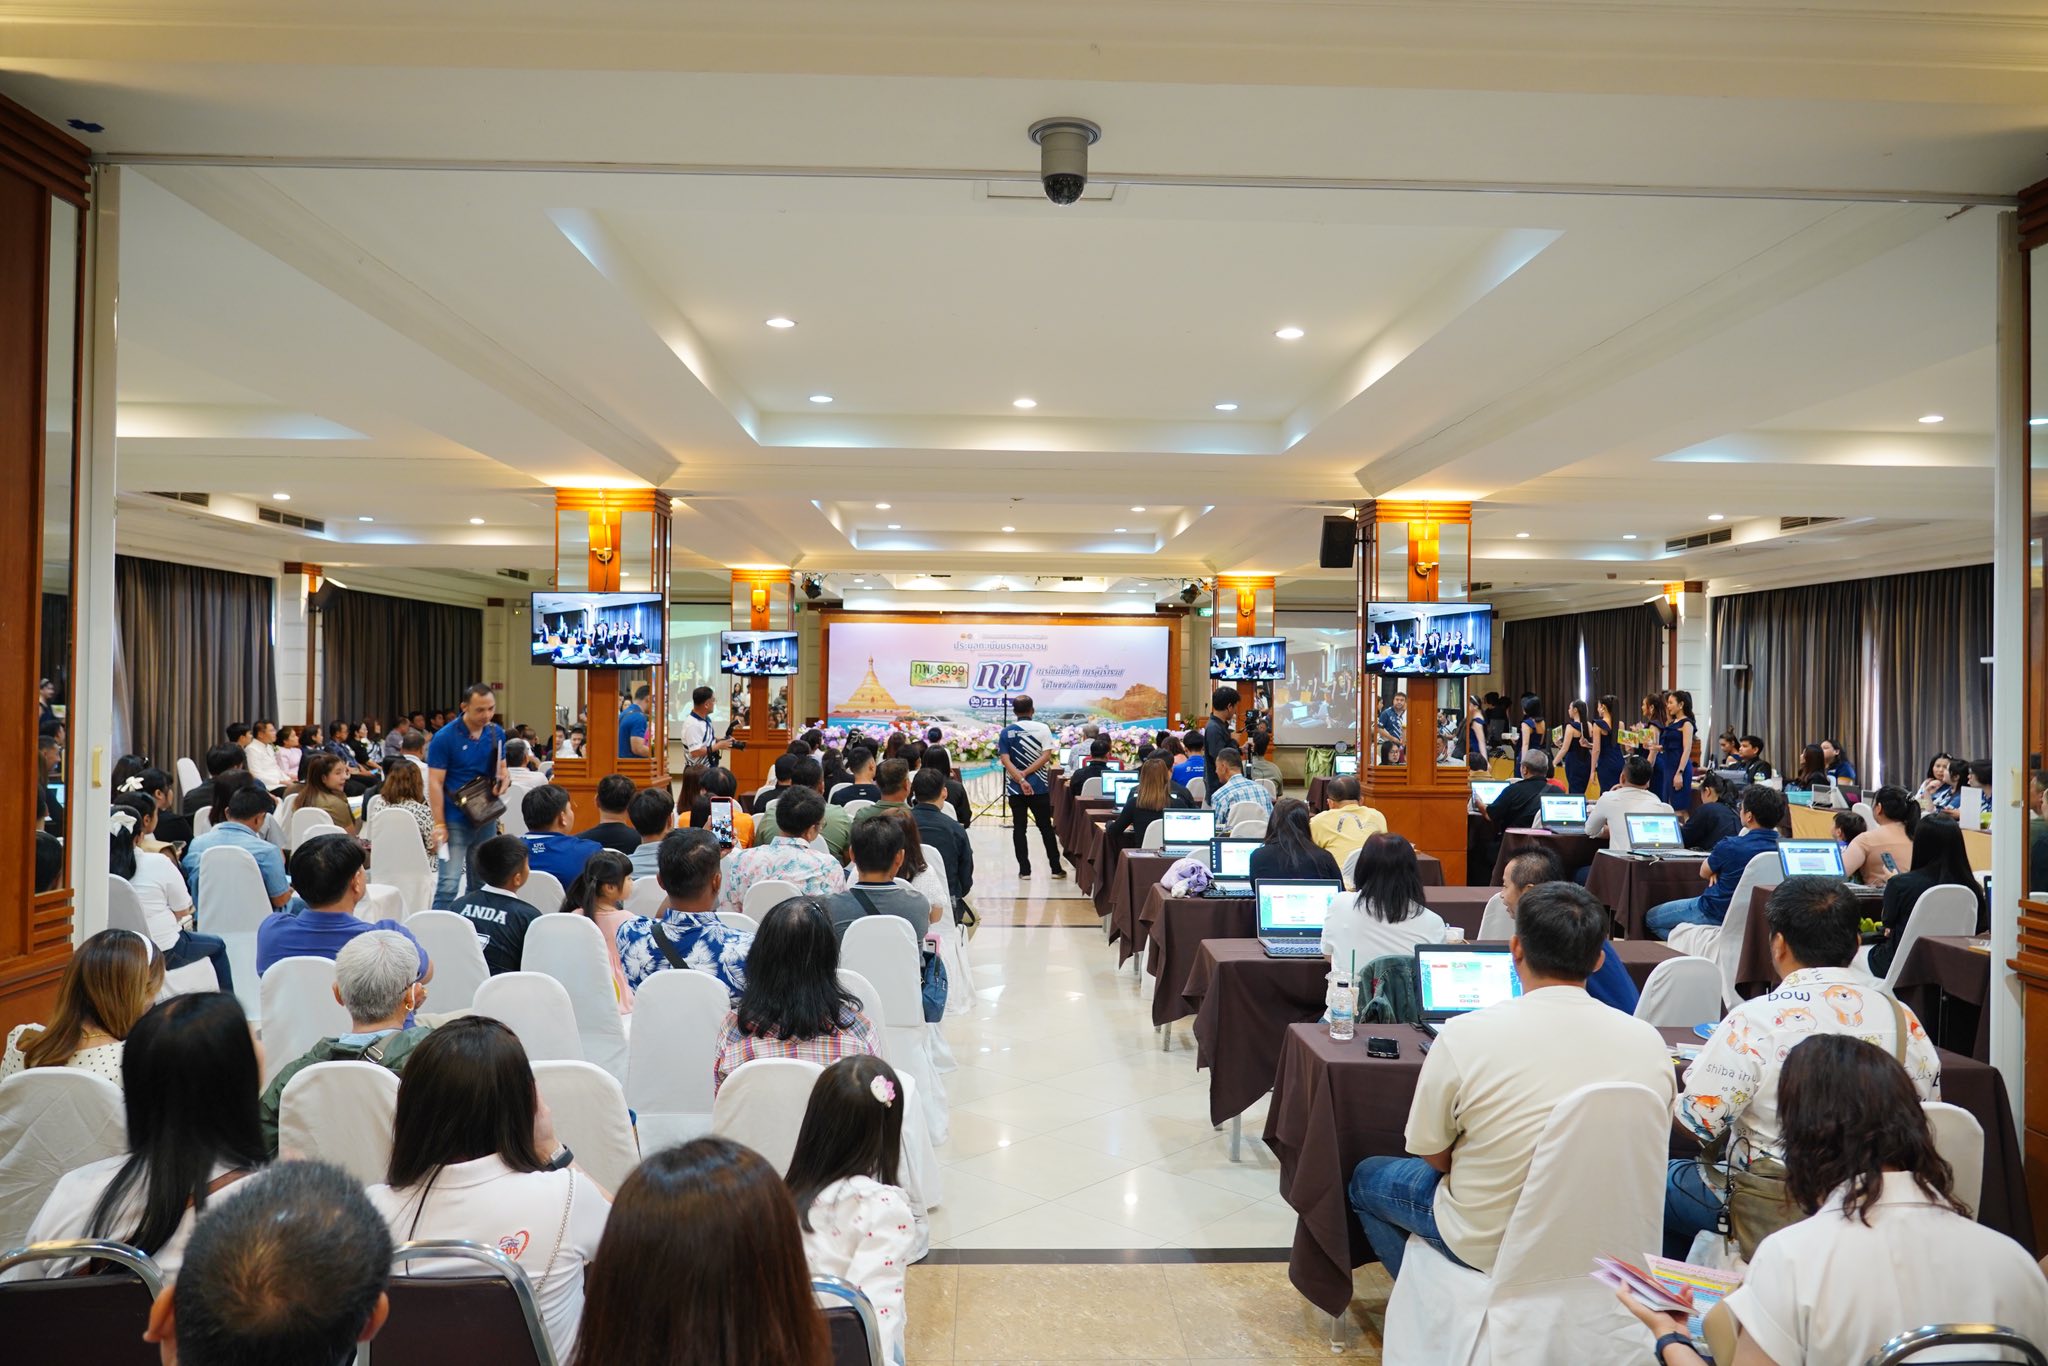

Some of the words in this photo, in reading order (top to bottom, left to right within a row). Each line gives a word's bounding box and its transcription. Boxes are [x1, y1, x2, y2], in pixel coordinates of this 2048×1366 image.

[937, 665, 965, 675] 9999
[977, 663, 1028, 689] กพ
[983, 698, 993, 706] 21
[460, 903, 508, 925] ANDA
[1767, 987, 1811, 1003] bow
[1705, 1063, 1735, 1079] shiba
